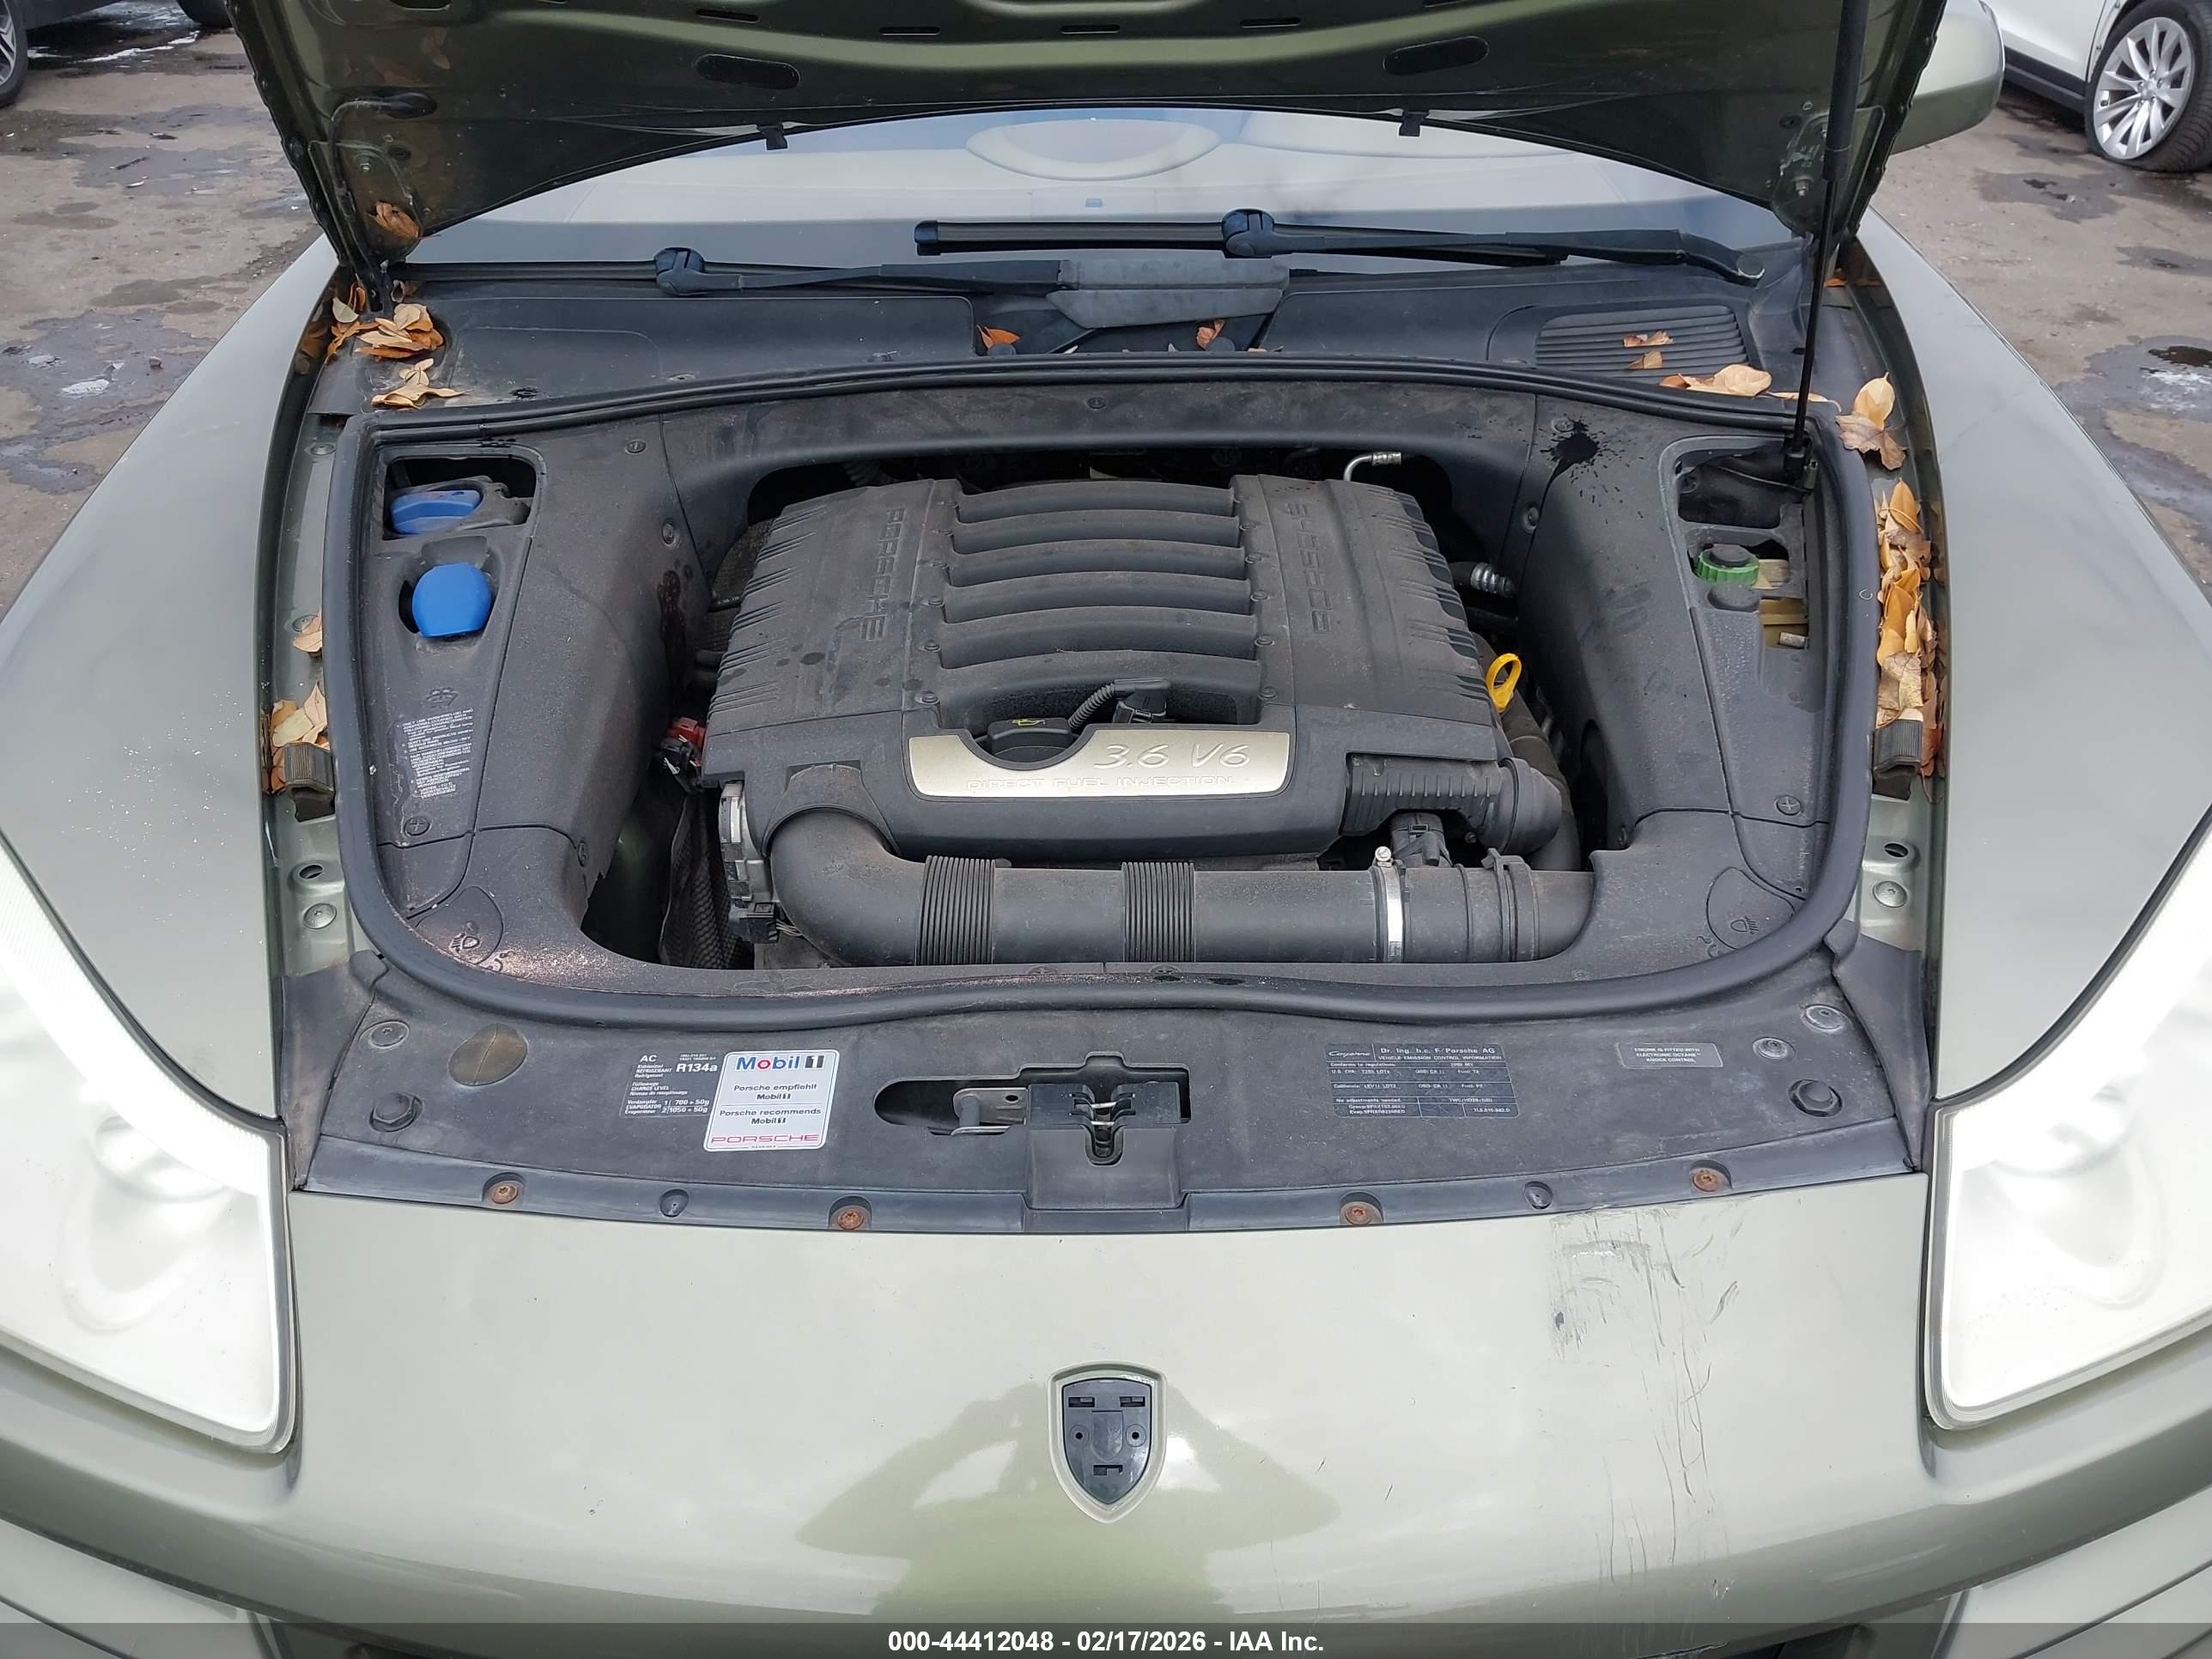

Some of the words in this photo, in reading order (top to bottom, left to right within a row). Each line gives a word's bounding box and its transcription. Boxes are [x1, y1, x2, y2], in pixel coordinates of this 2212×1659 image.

[860, 507, 906, 641] PORSCHE
[1093, 743, 1171, 770] 3.6
[1191, 743, 1251, 769] V6
[967, 778, 1045, 790] DIRECT
[1053, 777, 1110, 788] FUEL
[1117, 775, 1234, 787] INJECTION
[676, 1063, 718, 1072] R134a
[737, 1056, 800, 1070] Mobil
[711, 1134, 820, 1144] PORSCHE
